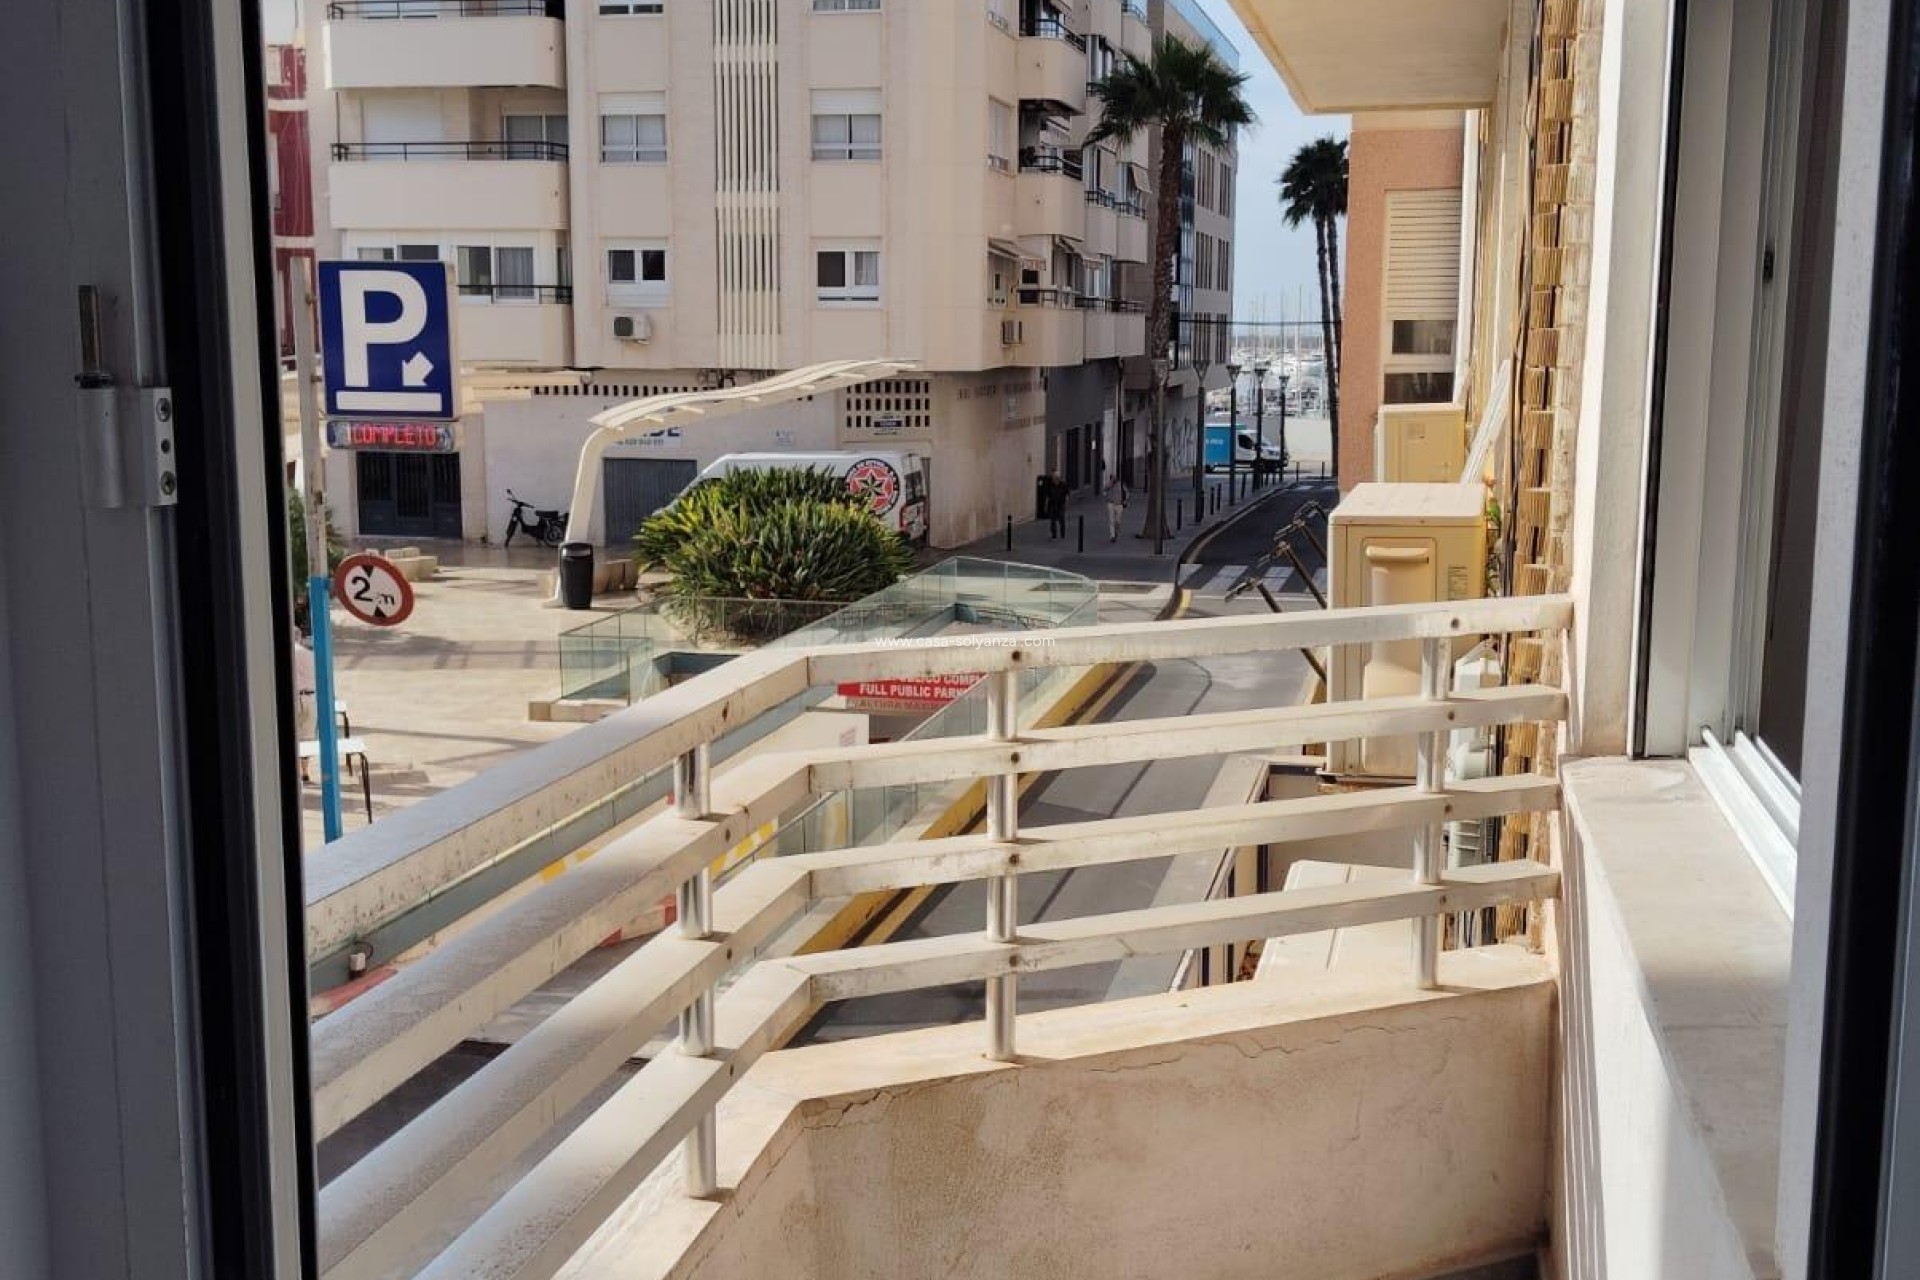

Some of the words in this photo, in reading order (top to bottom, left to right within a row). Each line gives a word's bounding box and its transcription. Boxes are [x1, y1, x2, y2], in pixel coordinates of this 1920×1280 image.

[339, 270, 428, 388] P
[860, 681, 888, 696] FULL
[889, 683, 932, 698] PUBLIC
